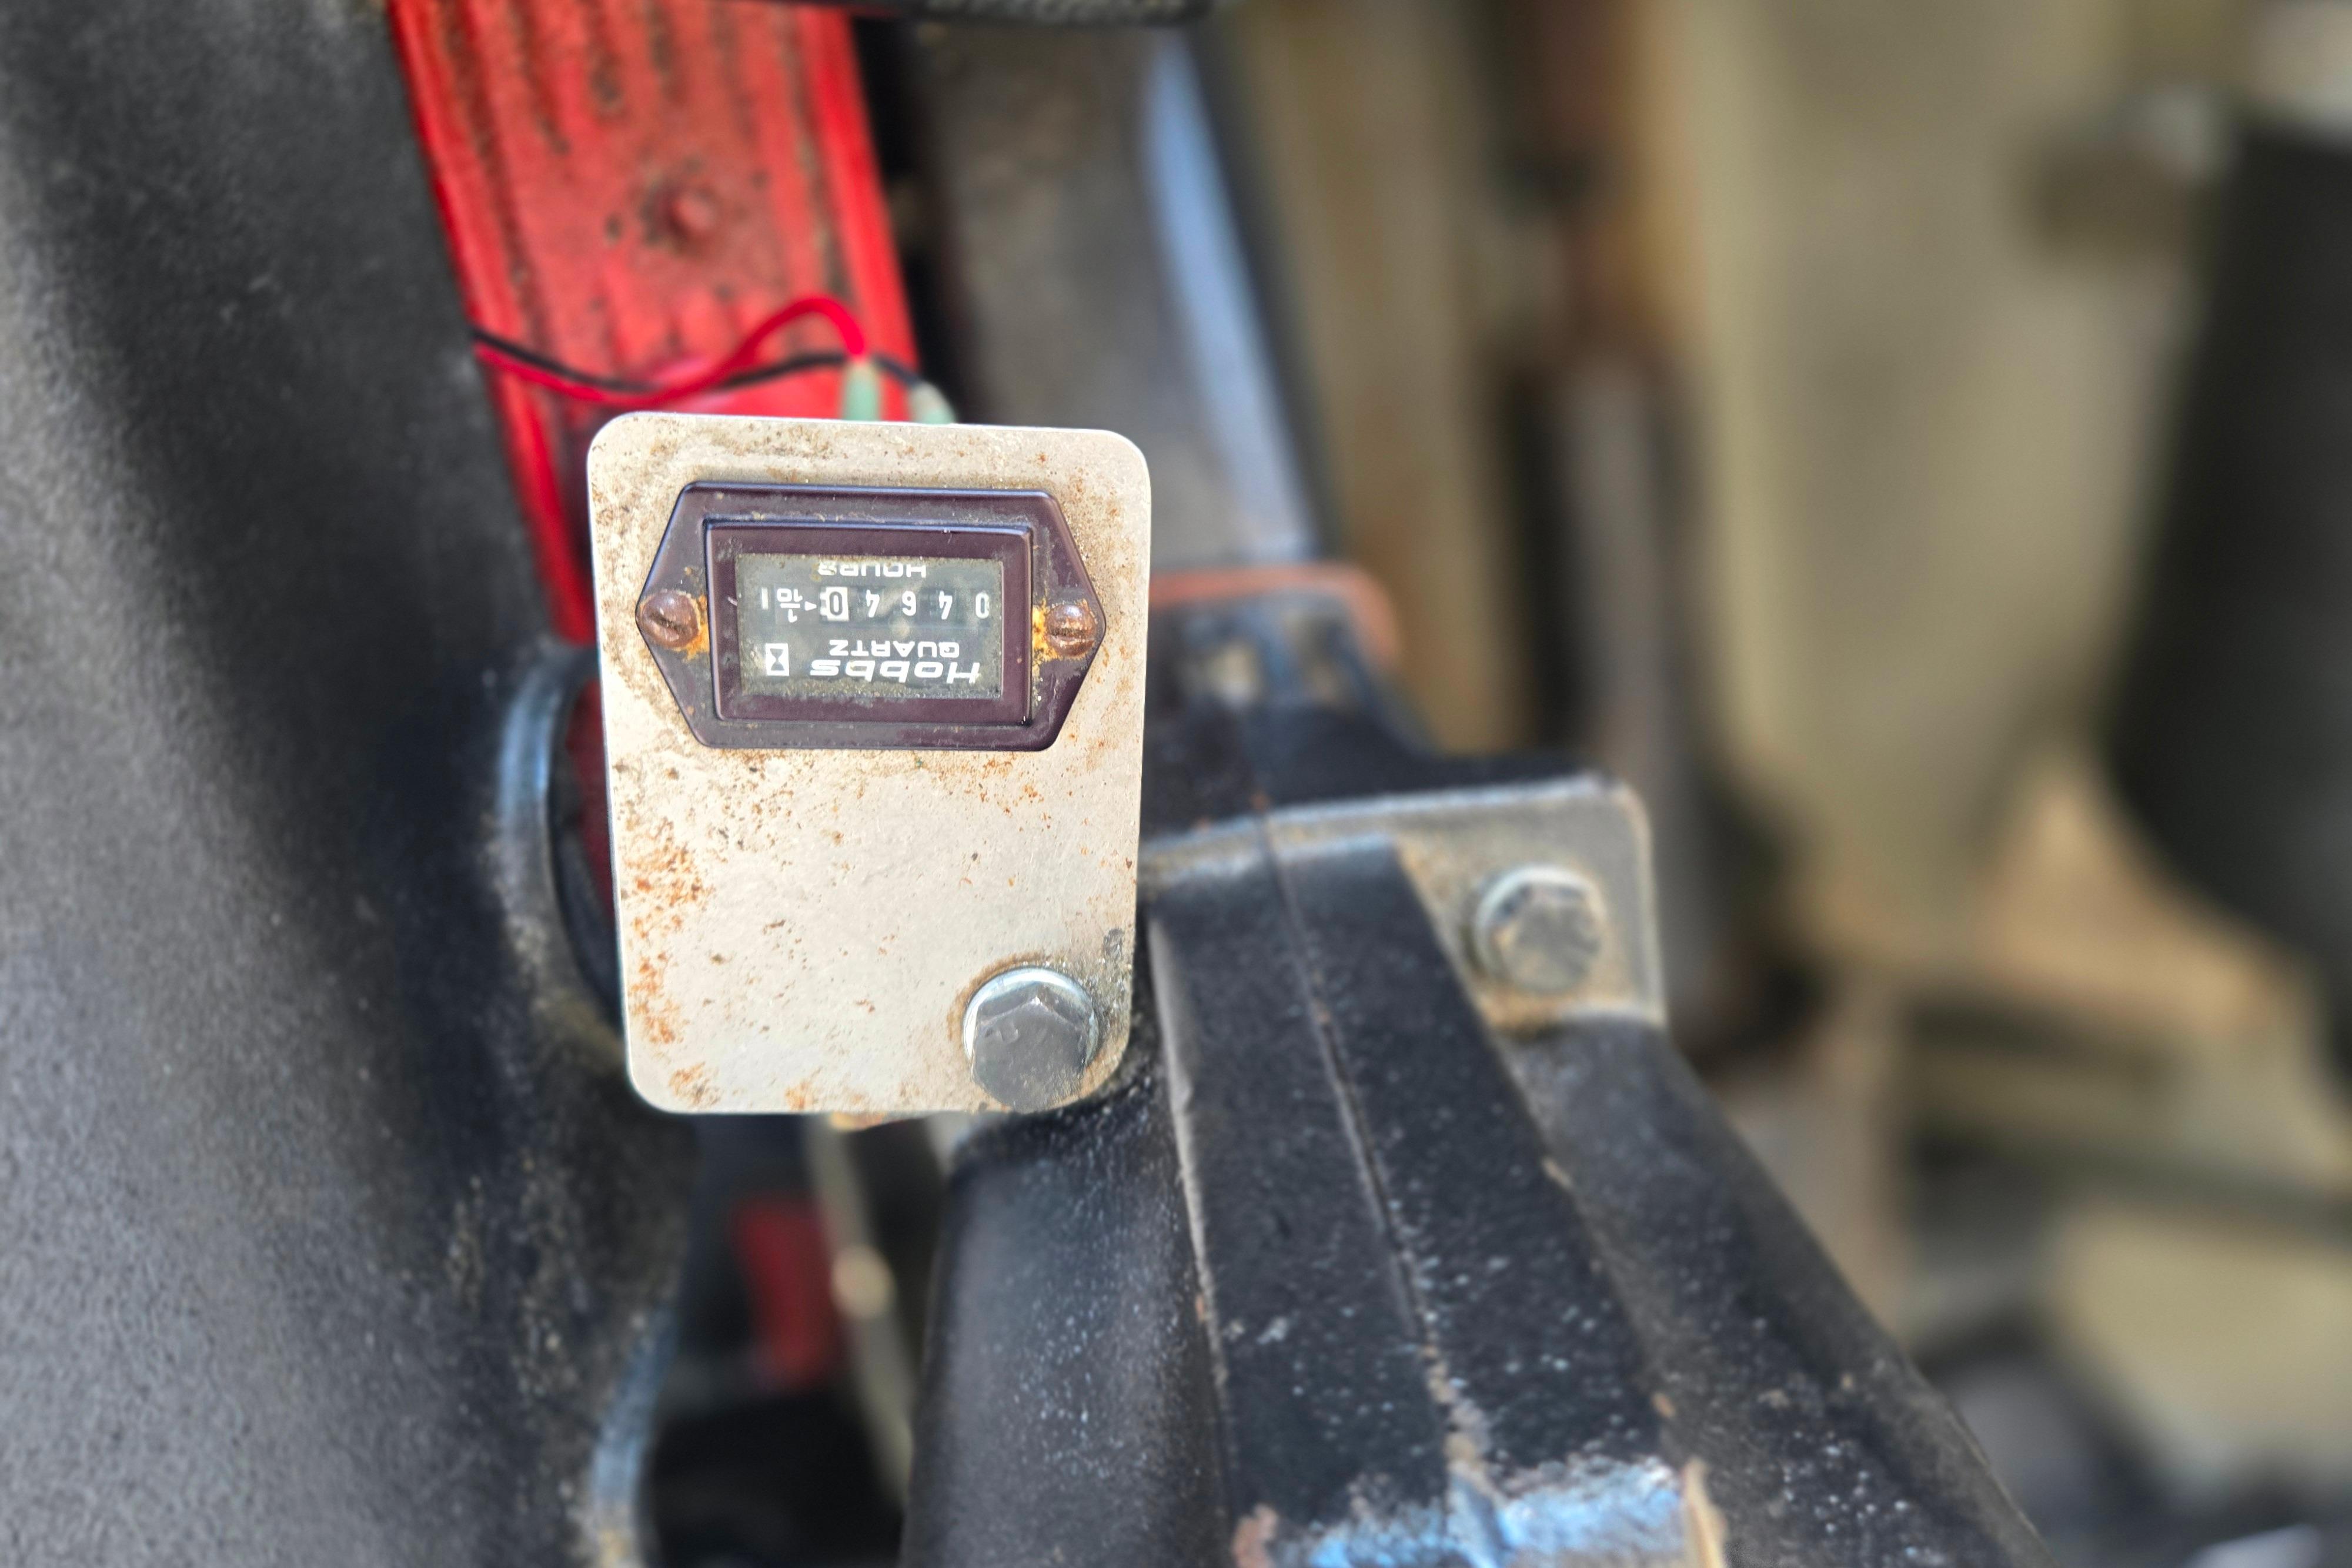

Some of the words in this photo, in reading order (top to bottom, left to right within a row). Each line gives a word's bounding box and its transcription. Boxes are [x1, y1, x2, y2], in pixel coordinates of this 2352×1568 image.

[817, 561, 927, 578] HOURS
[828, 640, 960, 658] QUARTZ
[809, 660, 981, 684] Hobbs
